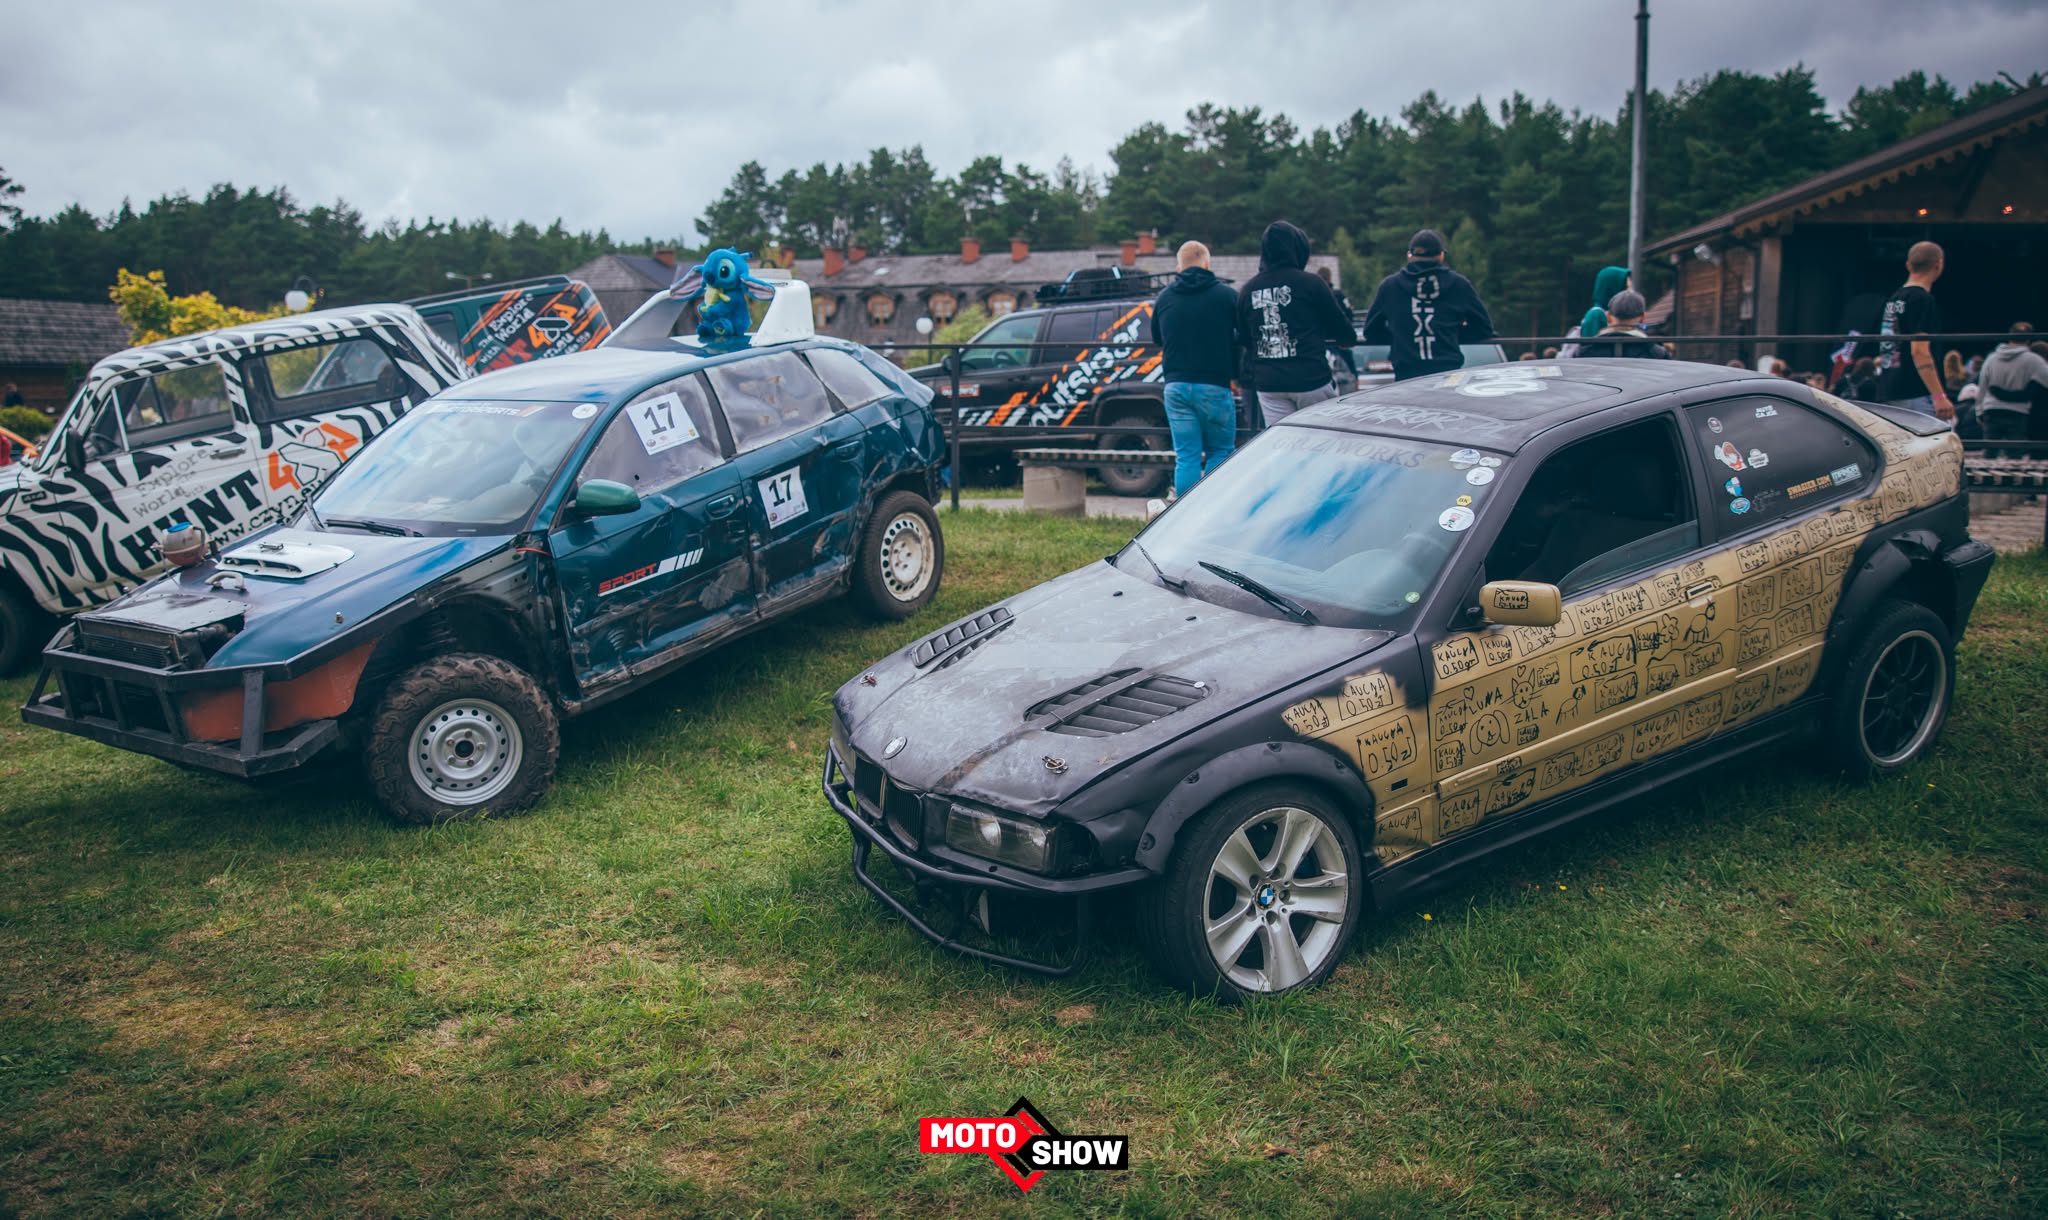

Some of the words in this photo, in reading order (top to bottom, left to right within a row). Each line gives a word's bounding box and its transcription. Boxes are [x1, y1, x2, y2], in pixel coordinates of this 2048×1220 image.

[489, 293, 534, 331] Explore
[495, 308, 535, 341] World
[644, 401, 675, 435] 17
[136, 448, 209, 497] Explore
[133, 486, 185, 518] World
[768, 474, 792, 507] 17
[599, 563, 657, 593] SPORT
[1469, 687, 1503, 714] LUNA
